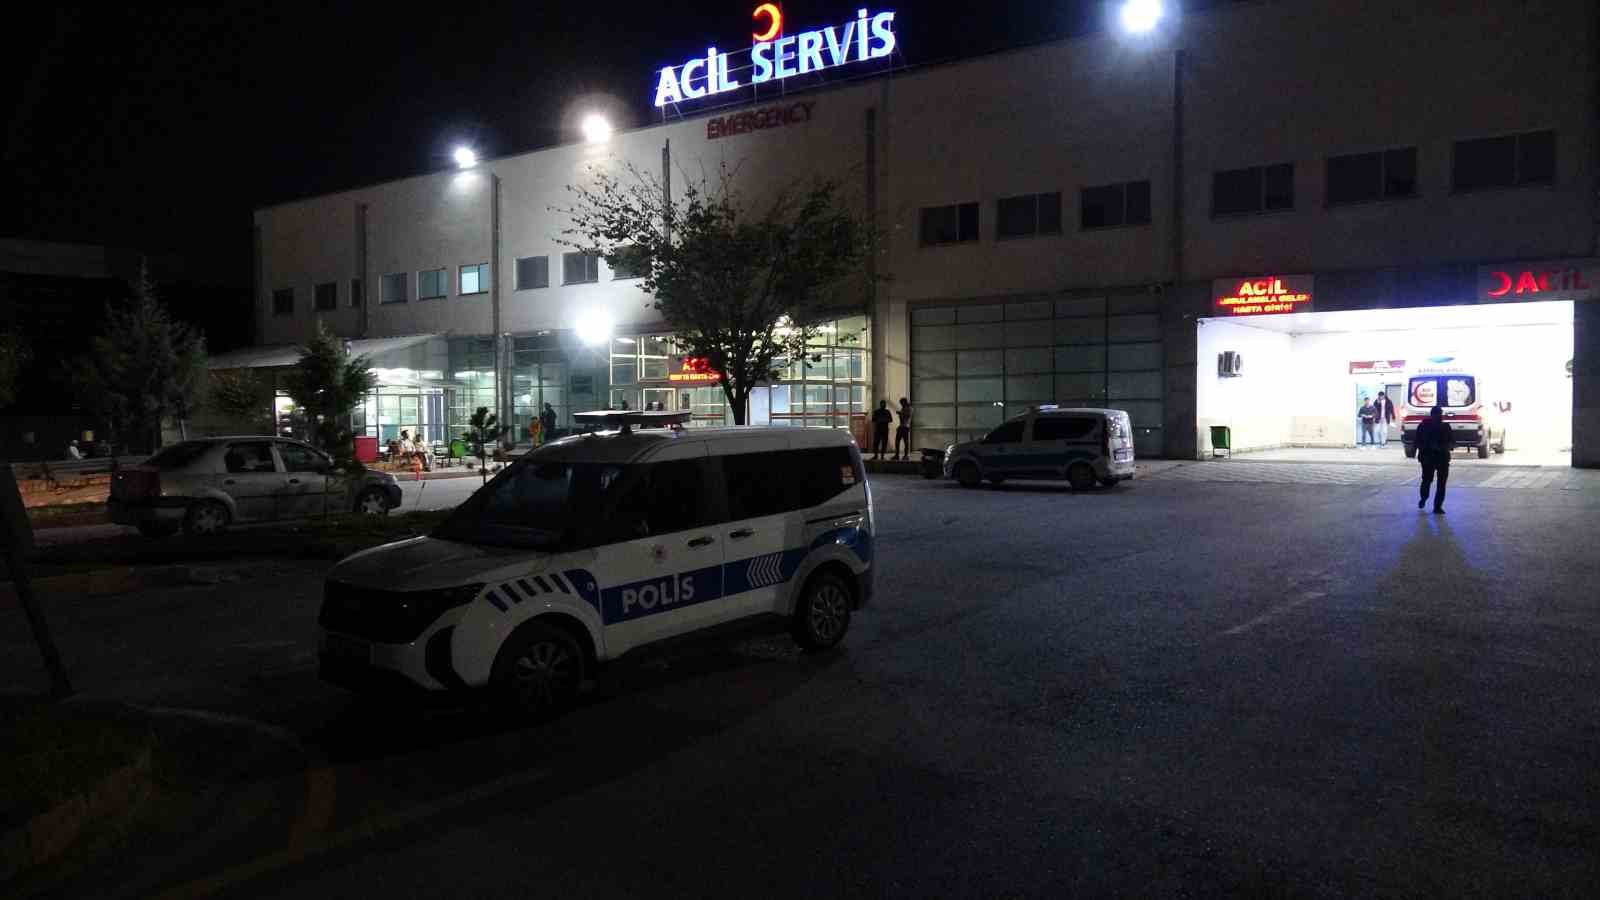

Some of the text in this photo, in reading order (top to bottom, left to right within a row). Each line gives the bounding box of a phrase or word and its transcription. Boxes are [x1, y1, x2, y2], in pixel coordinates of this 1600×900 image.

[654, 8, 896, 106] ACİL SERVİS
[707, 104, 813, 139] EMERGENCY
[1239, 276, 1287, 295] ACİL
[622, 573, 695, 613] POLİS
